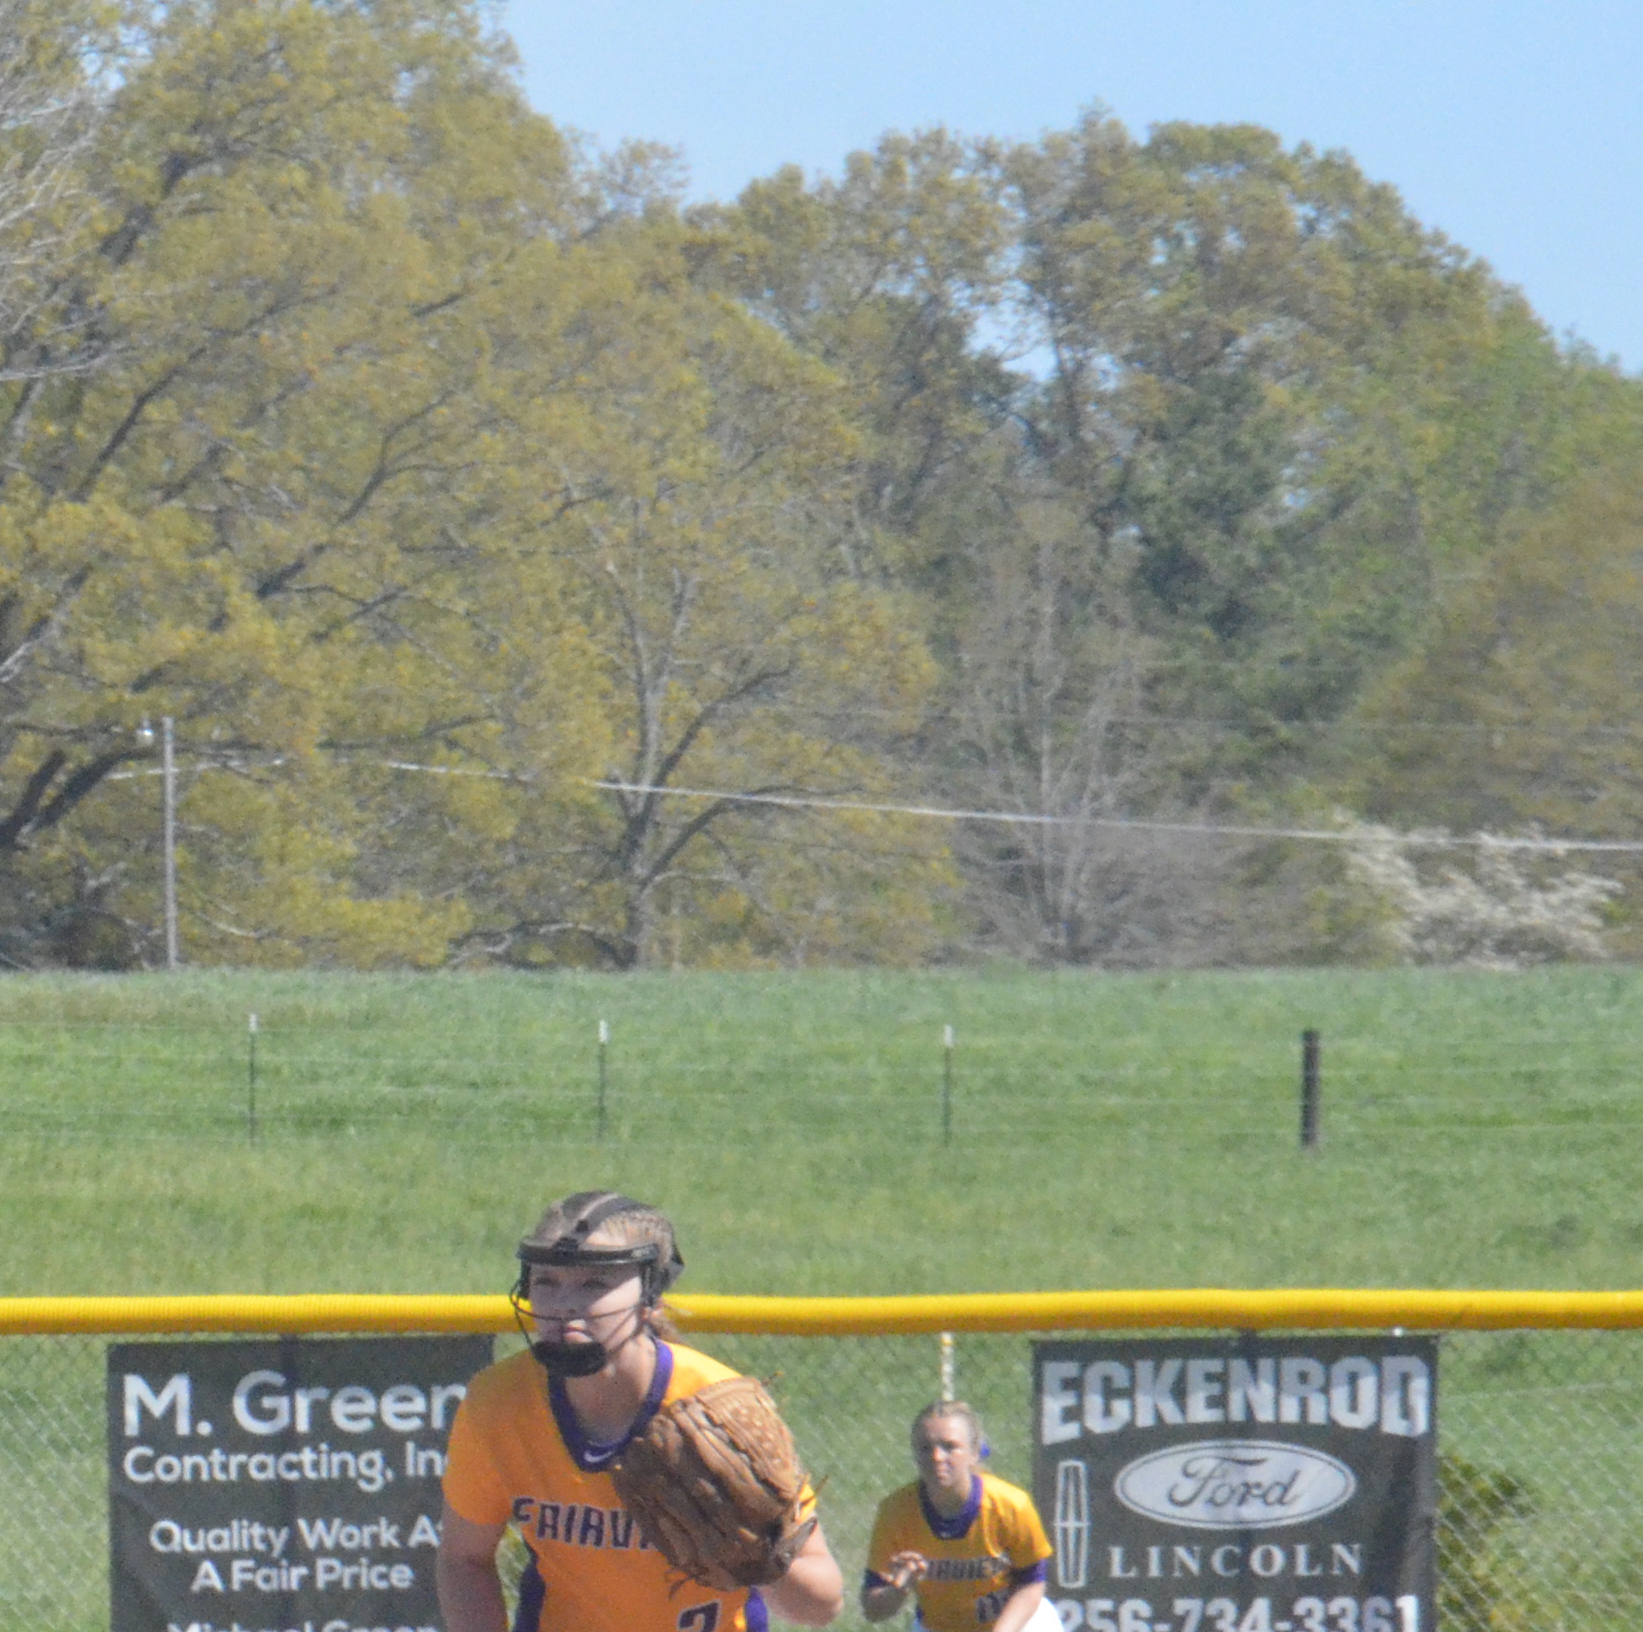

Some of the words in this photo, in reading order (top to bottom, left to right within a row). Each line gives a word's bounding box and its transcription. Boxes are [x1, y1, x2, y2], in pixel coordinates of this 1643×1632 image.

[123, 1373, 213, 1437] M.
[1042, 1355, 1430, 1446] ECKENROD
[123, 1443, 394, 1492] Contracting,
[405, 1441, 449, 1477] In
[1167, 1455, 1303, 1508] Ford
[149, 1518, 289, 1557] Quality
[297, 1517, 400, 1550] Work
[407, 1514, 443, 1548] A
[1108, 1542, 1364, 1578] LINCOLN
[191, 1560, 225, 1593] A
[231, 1559, 309, 1591] Fair
[316, 1557, 415, 1590] Price
